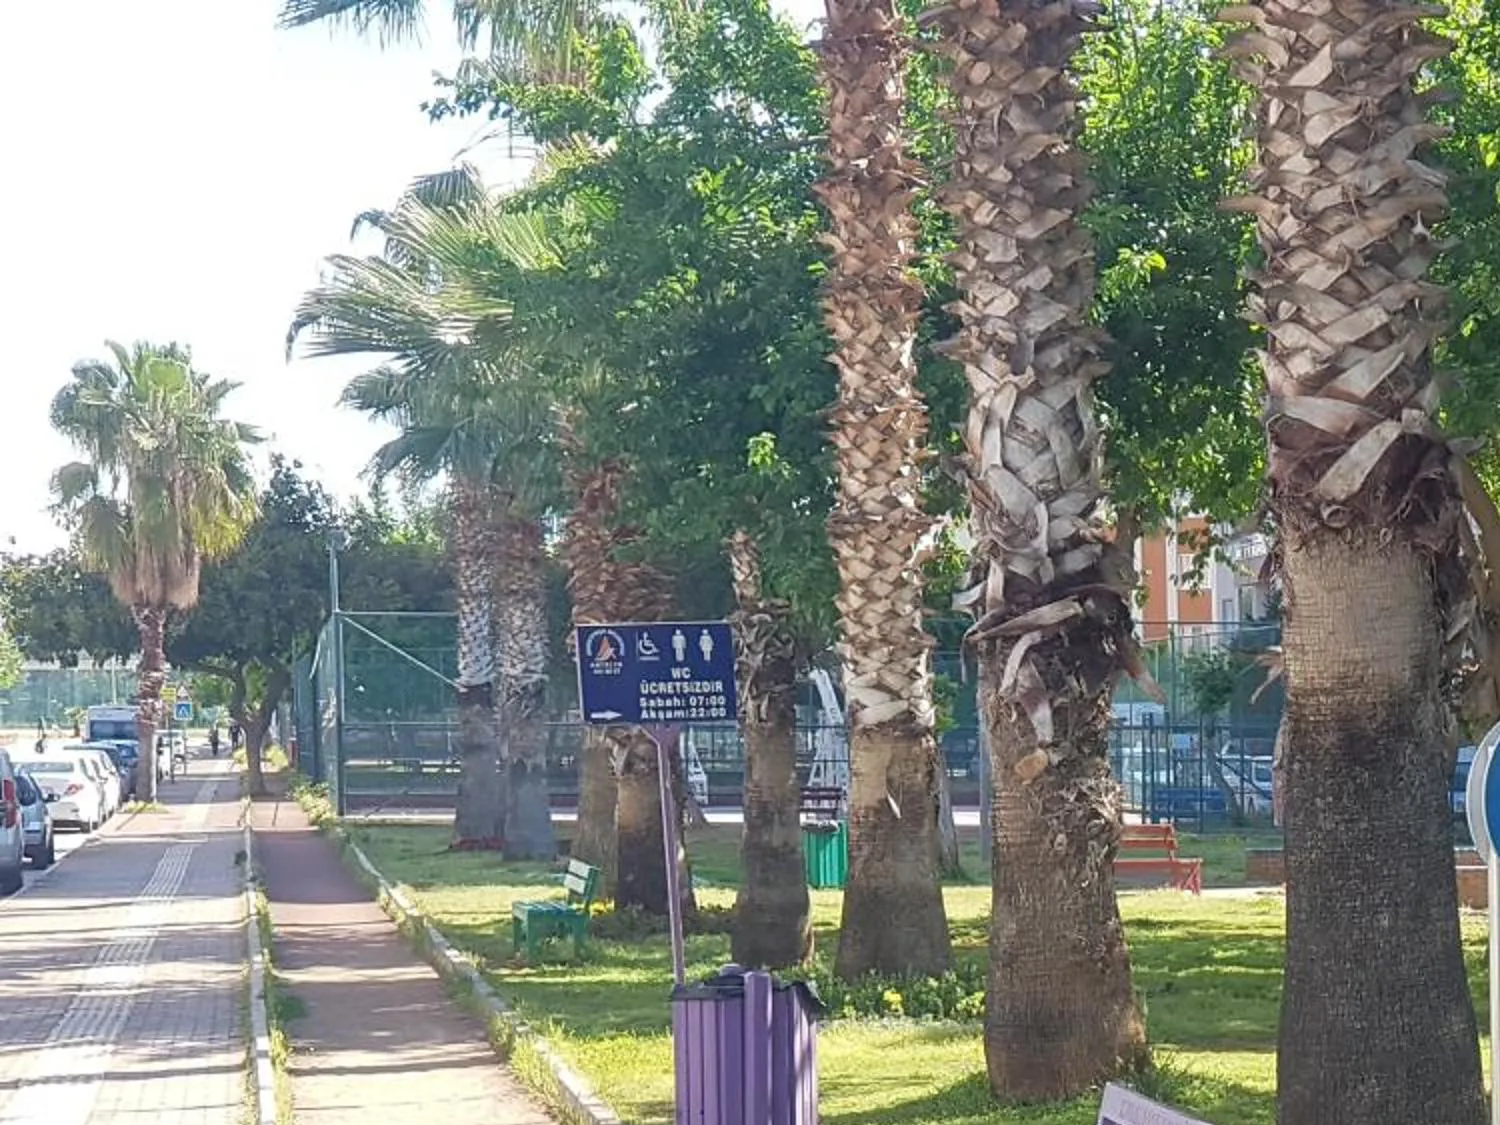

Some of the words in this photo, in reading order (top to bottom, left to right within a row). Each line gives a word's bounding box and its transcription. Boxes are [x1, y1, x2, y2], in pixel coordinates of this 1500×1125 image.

[671, 667, 691, 679] WC
[640, 697, 685, 707] Sabah:
[690, 696, 726, 707] 07:00
